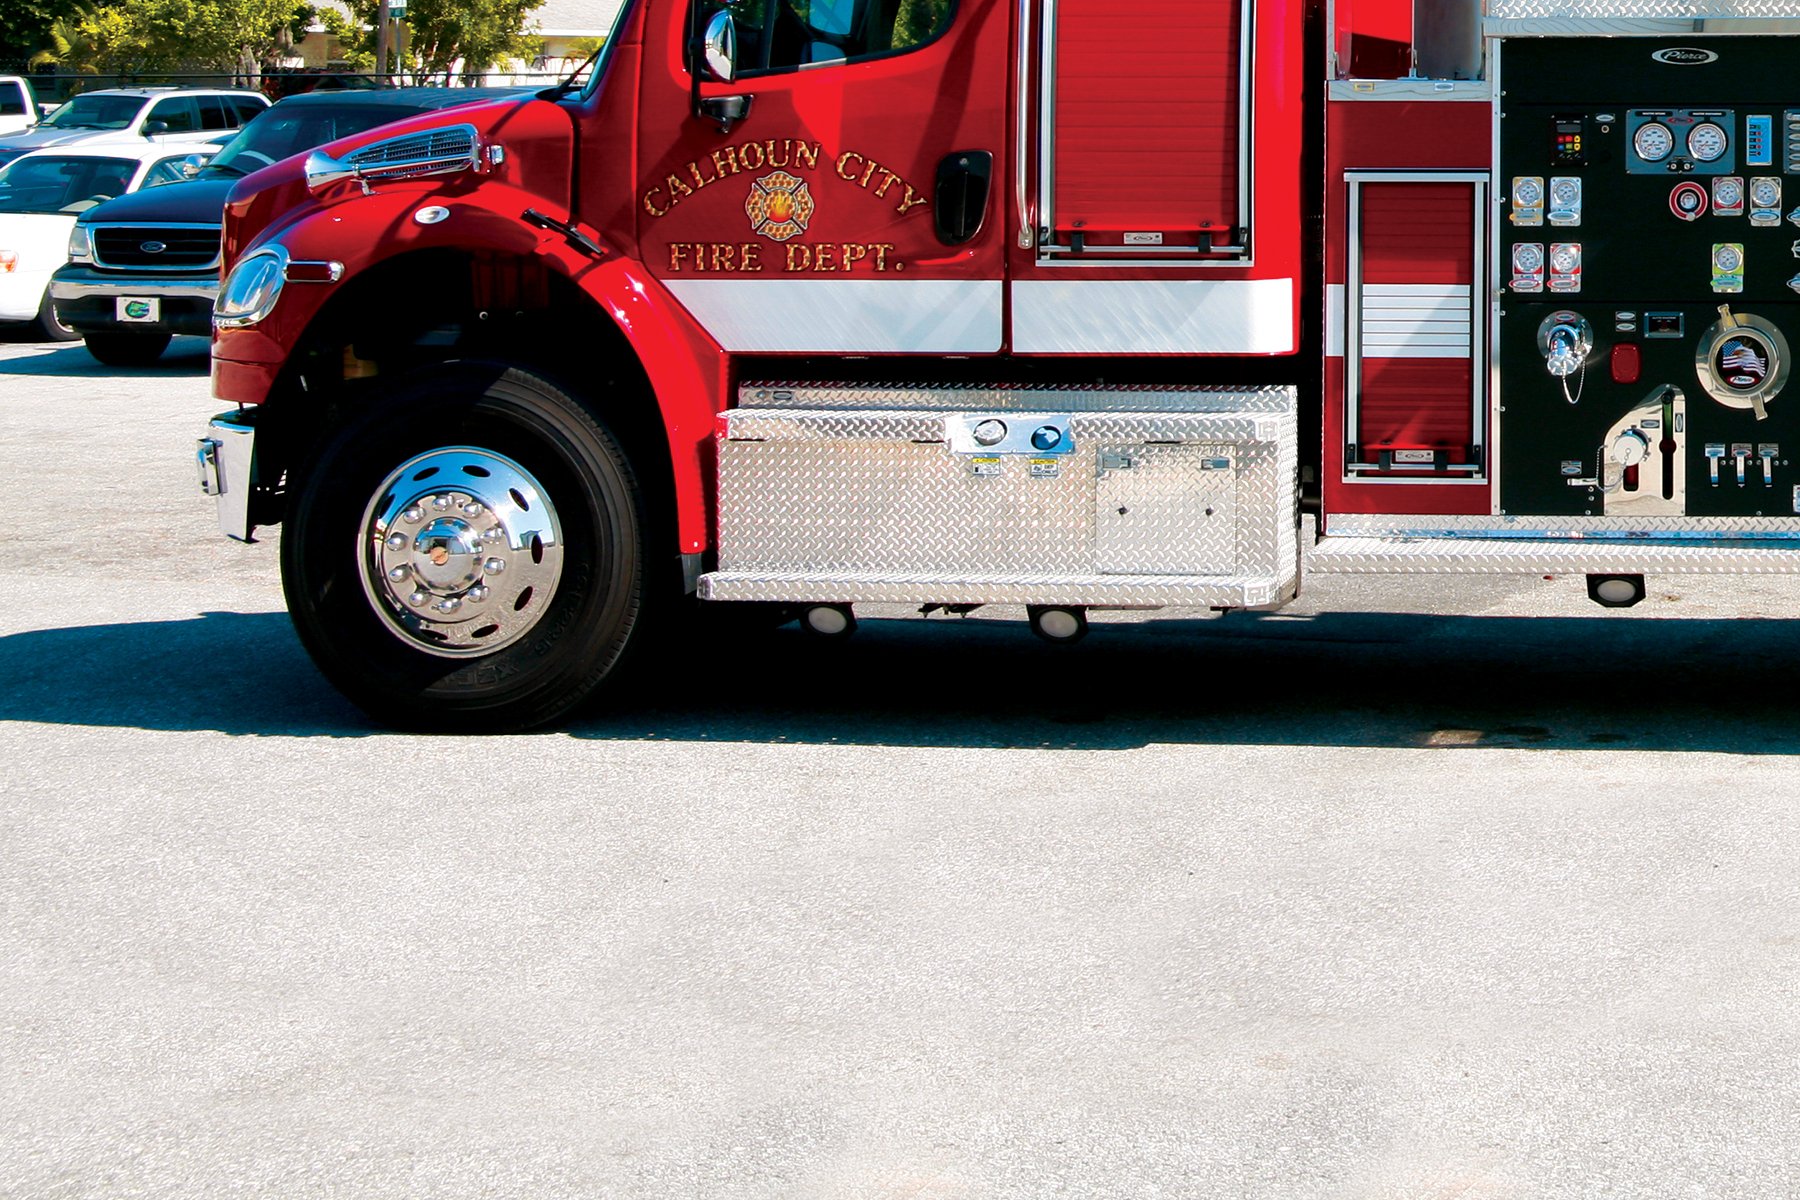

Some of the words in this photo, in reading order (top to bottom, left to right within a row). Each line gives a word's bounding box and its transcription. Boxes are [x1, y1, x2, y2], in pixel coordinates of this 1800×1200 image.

[1663, 50, 1708, 60] Pierce
[642, 138, 822, 218] CALHOUN
[834, 150, 928, 216] CITY
[667, 242, 763, 272] FIRE
[783, 242, 905, 272] DEPT.
